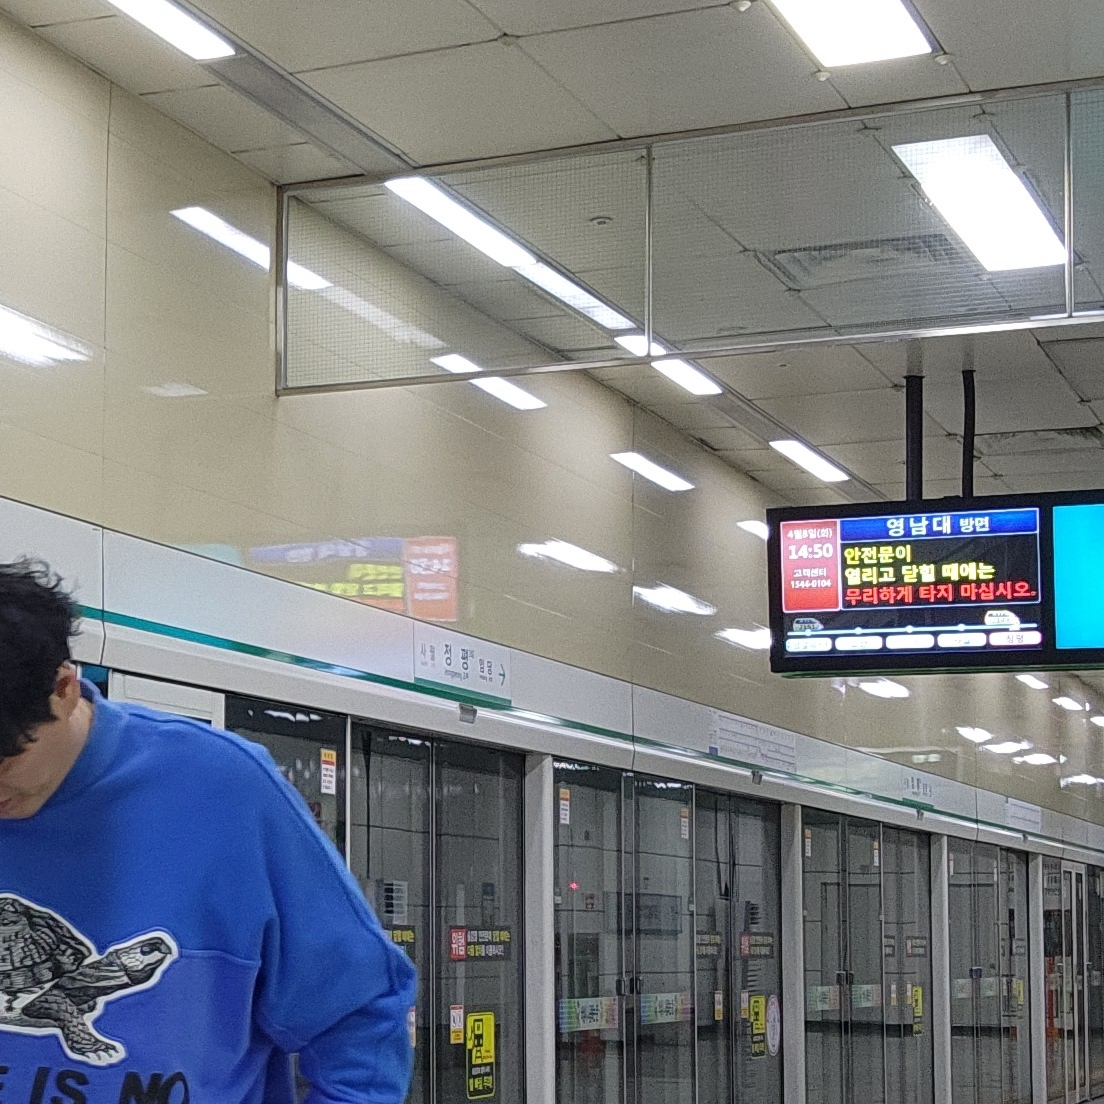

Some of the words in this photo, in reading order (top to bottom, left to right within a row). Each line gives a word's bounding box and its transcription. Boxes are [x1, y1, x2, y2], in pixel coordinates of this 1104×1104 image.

[886, 516, 951, 536] 영남대
[959, 516, 990, 532] 방면
[788, 543, 833, 559] 14:50
[844, 545, 911, 564] 안전문이
[845, 567, 895, 585] 열리고
[901, 564, 936, 584] 닫힐
[942, 562, 995, 581] 때에는
[845, 586, 913, 604] 무리하게
[919, 584, 953, 602] 타지
